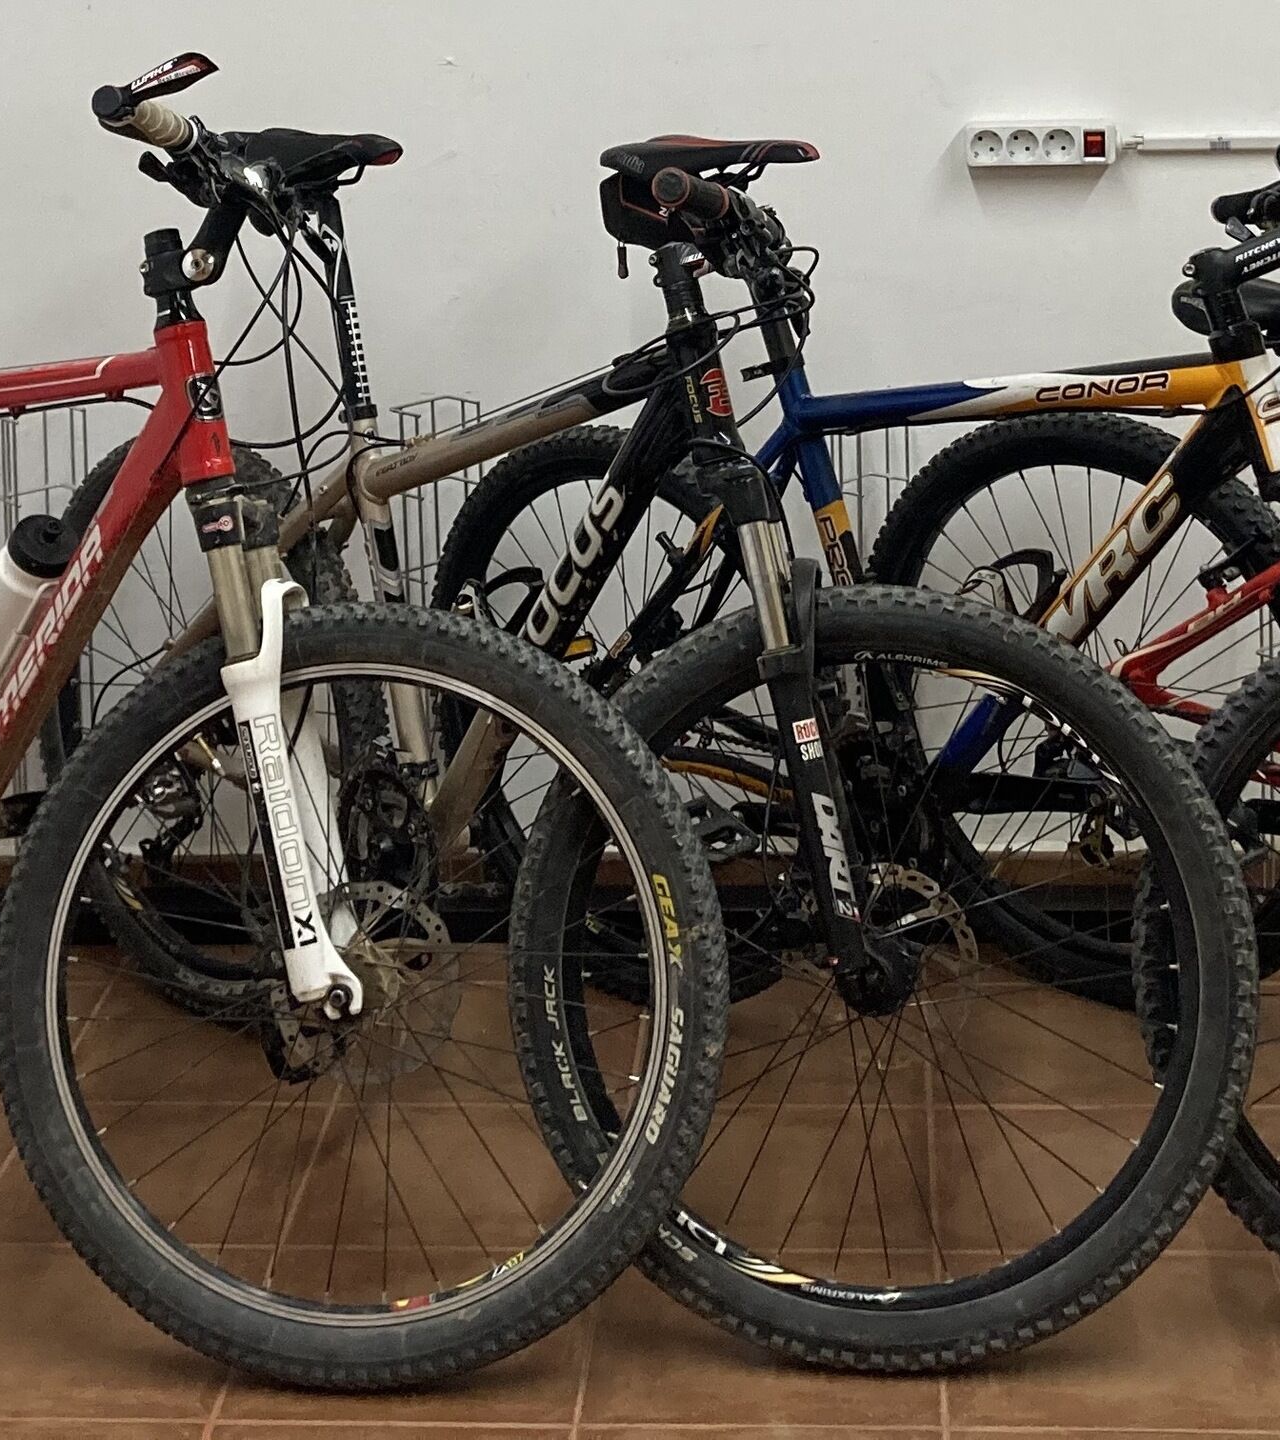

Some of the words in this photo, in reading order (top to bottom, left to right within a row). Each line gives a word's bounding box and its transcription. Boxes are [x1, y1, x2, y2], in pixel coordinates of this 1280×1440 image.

[684, 375, 703, 424] FOCUS
[1035, 372, 1170, 404] CONOR
[519, 472, 626, 646] OCUS
[795, 722, 819, 738] ROC
[800, 742, 823, 761] SHO
[254, 714, 311, 911] Raidon
[811, 792, 854, 892] DART
[652, 873, 684, 972] GEAX
[543, 963, 560, 1031] JACK
[551, 1040, 588, 1122] BLACK
[645, 1007, 684, 1145] SAGUARO
